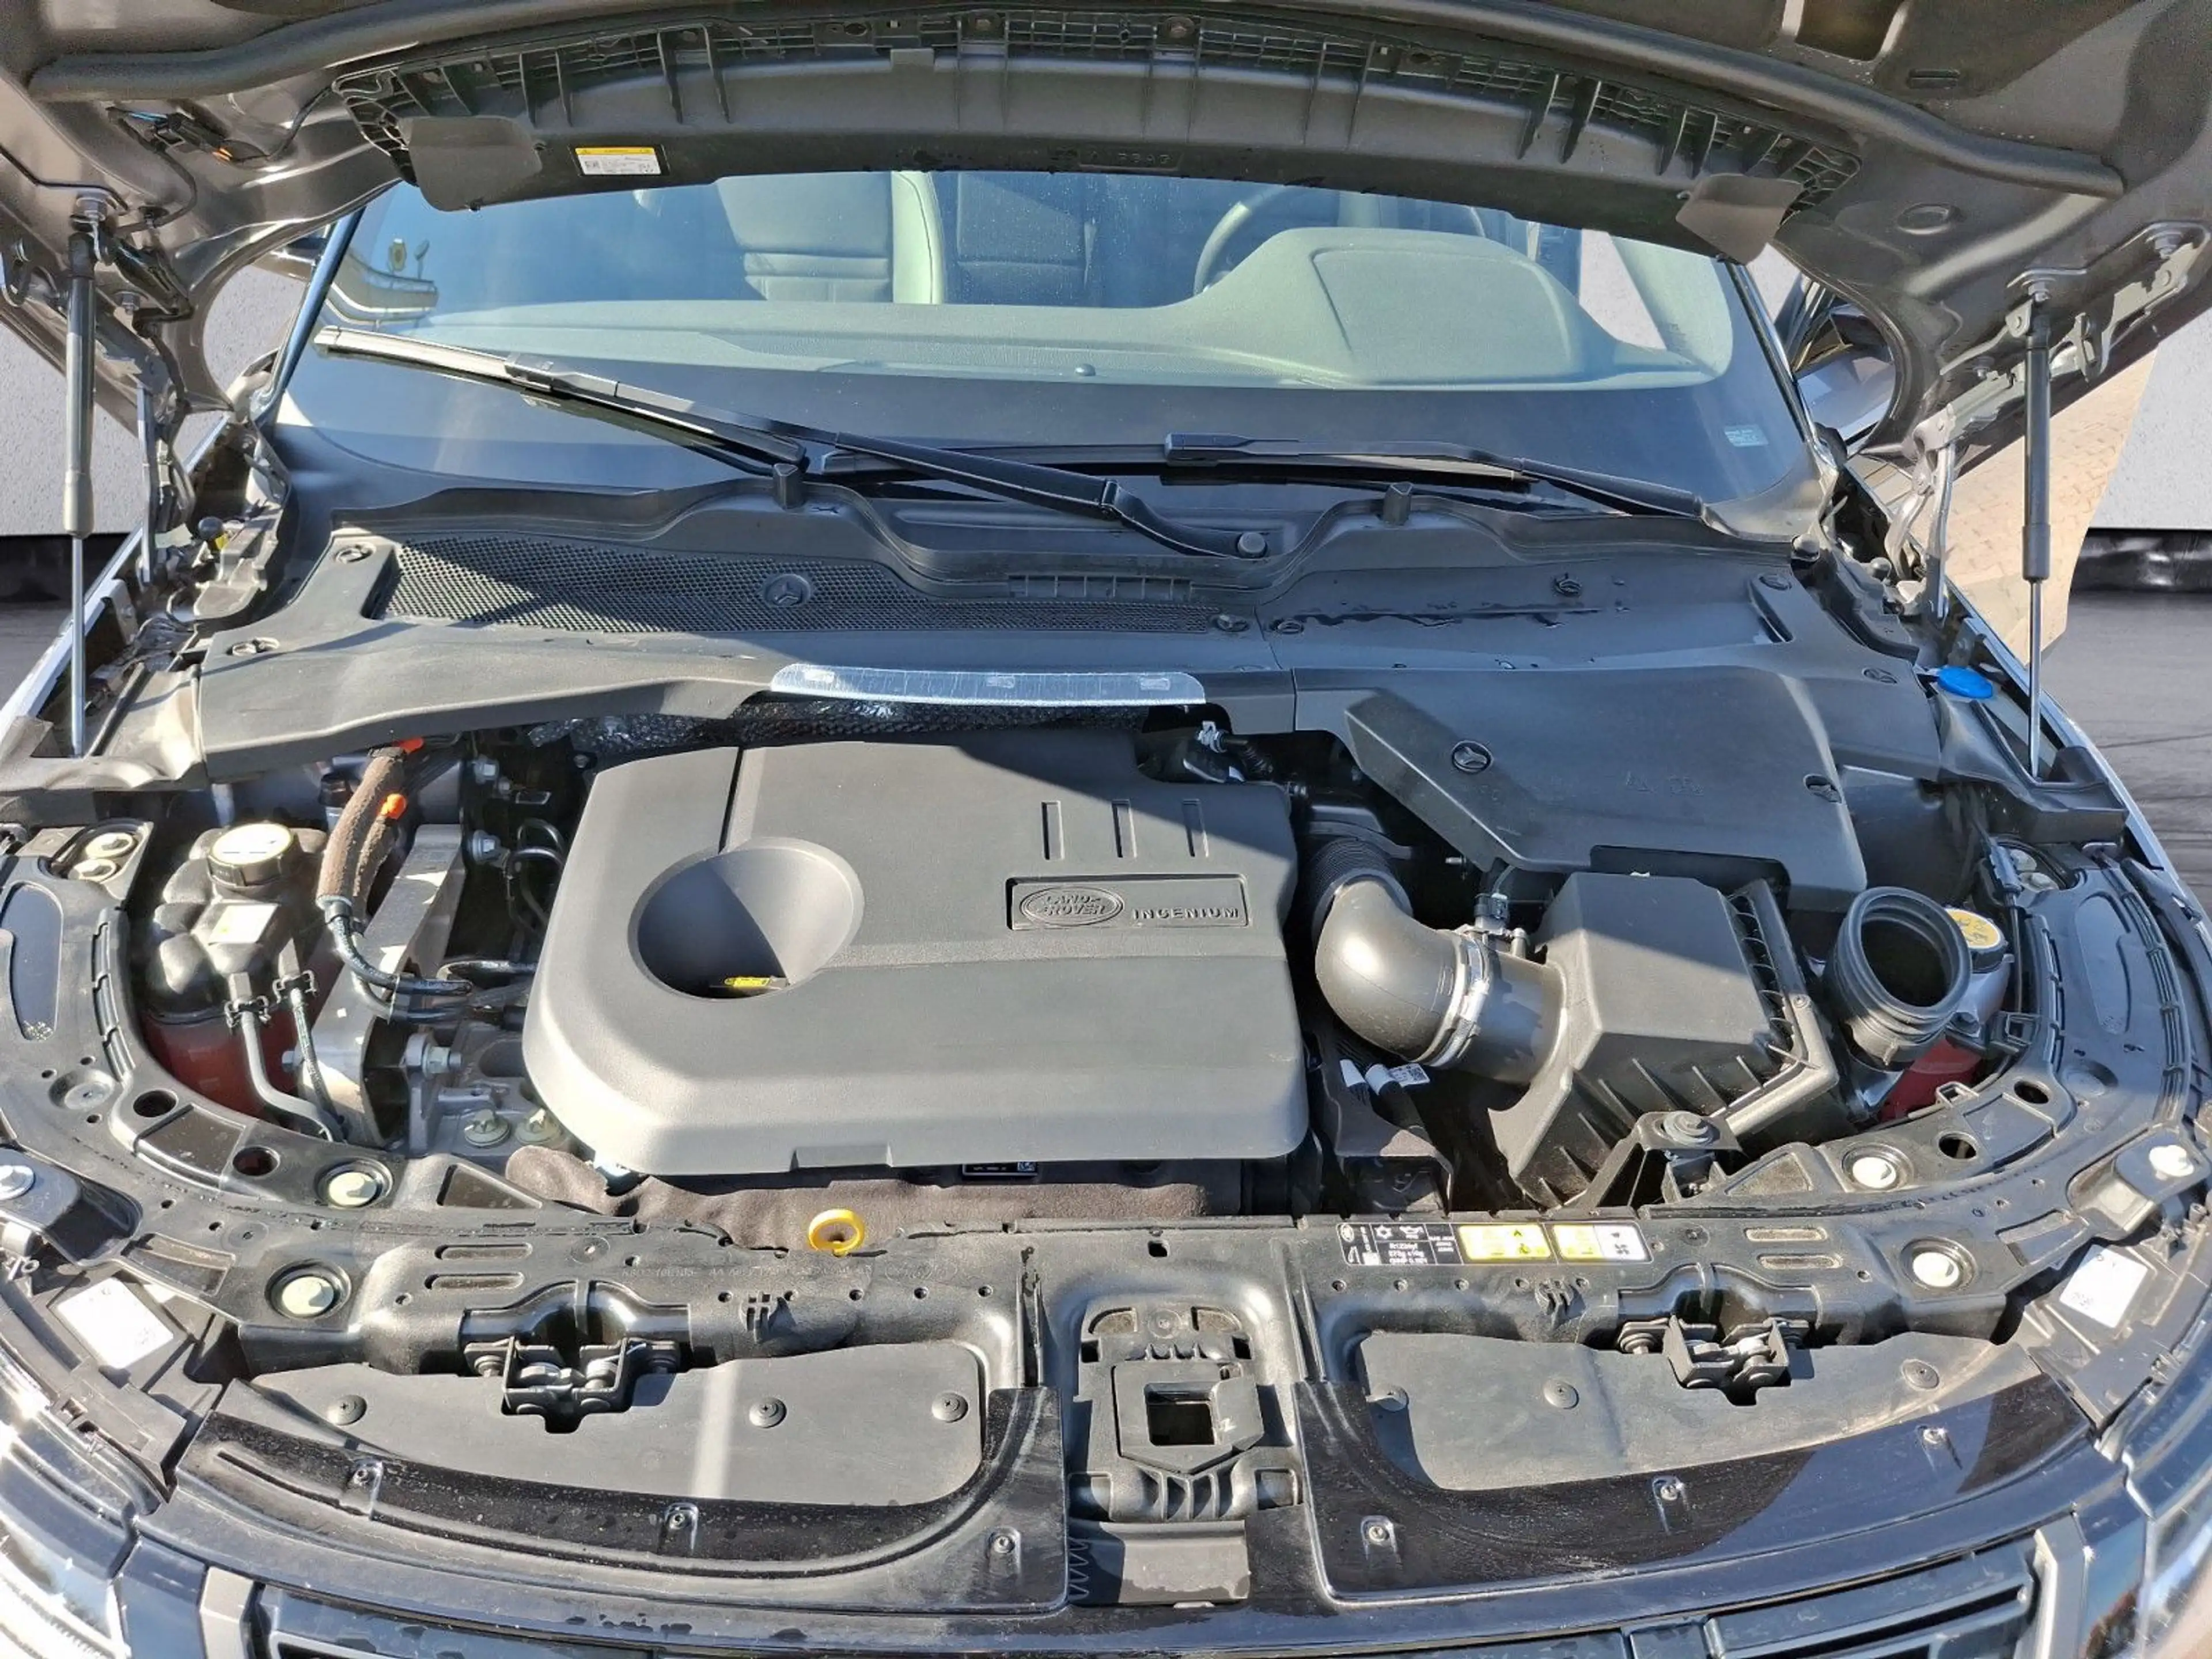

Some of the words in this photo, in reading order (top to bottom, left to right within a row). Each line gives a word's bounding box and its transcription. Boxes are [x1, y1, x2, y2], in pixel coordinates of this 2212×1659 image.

[1046, 893, 1090, 905] LAND
[1046, 904, 1105, 916] ROVER
[1132, 907, 1240, 919] INGENIUM
